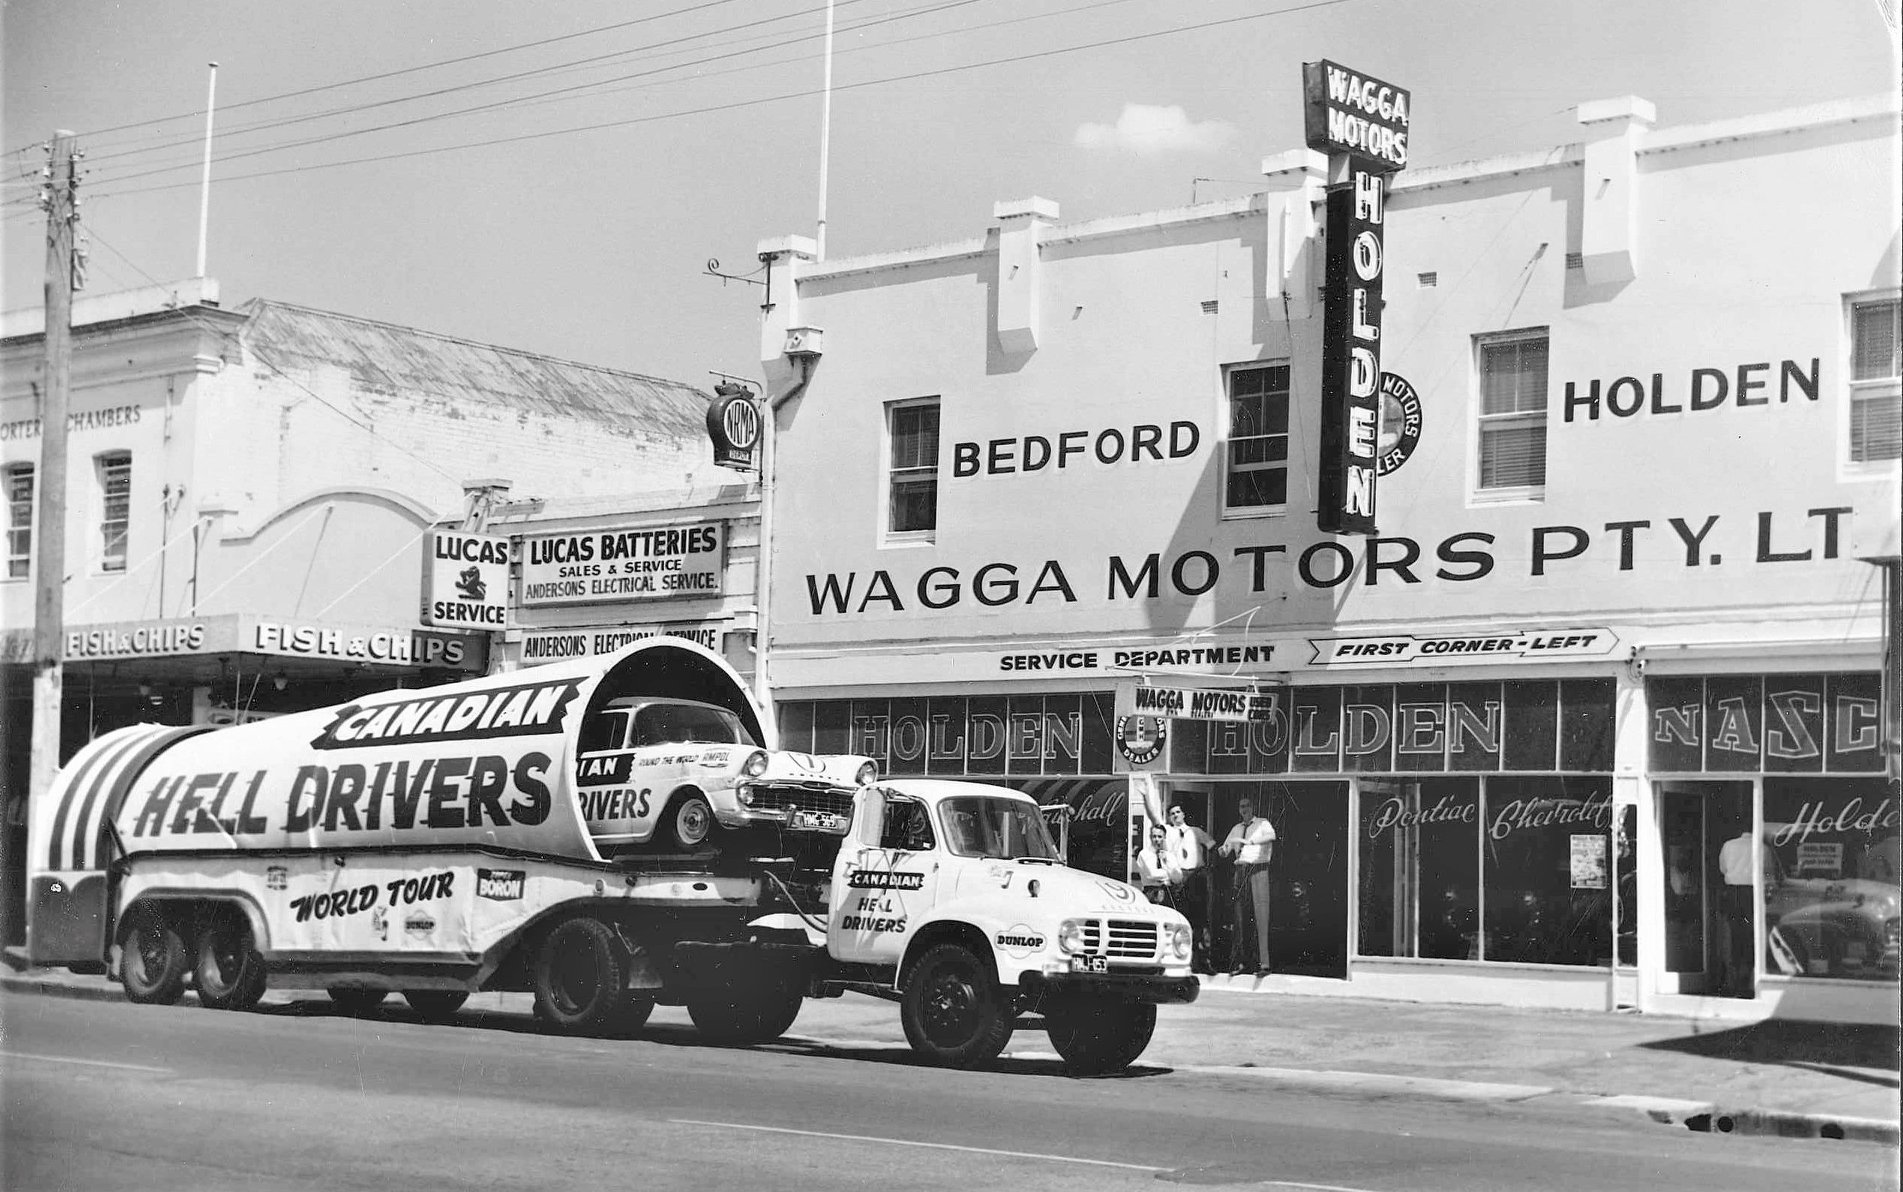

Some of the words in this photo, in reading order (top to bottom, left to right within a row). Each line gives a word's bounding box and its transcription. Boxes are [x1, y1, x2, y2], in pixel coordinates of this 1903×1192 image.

[1326, 65, 1409, 126] WAGGA
[1328, 107, 1408, 164] MOTORS
[1346, 171, 1383, 517] HOLDEN
[1383, 375, 1420, 438] MOTORS
[1563, 357, 1820, 423] HOLDEN
[66, 404, 141, 432] CHAMBERS
[727, 402, 755, 444] NRMA
[953, 420, 1200, 478] BEDFORD
[436, 535, 509, 565] LUCAS
[530, 536, 594, 565] LUCAS
[600, 526, 717, 561] BATTERIES
[805, 560, 1077, 615] WAGGA
[1108, 531, 1496, 600] MOTORS
[1531, 514, 1721, 576] PTY.
[525, 579, 586, 600] ANDERSONS
[592, 575, 654, 595] ELECTRICAL
[559, 564, 601, 578] SALES
[608, 564, 617, 575] &
[625, 559, 682, 574] SERVICE
[434, 602, 506, 625] SERVICE
[256, 622, 343, 655] FISH
[368, 632, 465, 665] CHIPS
[524, 635, 587, 658] ANDERSONS
[594, 632, 654, 656] ELECT
[665, 628, 717, 650] VICE
[1000, 653, 1098, 671] SERVICE
[1114, 646, 1275, 667] DEPARTMENT
[1336, 642, 1409, 657] FIRST
[335, 683, 569, 741] CANADIAN
[1136, 688, 1184, 710] WAGGA
[1190, 692, 1247, 713] MOTORS
[854, 711, 1082, 761] HOLDEN
[1211, 700, 1500, 756] HOLDEN
[1654, 690, 1878, 759] NASC
[703, 752, 730, 761] AMPOL
[133, 769, 268, 838] HELL
[281, 751, 552, 833] DRIVERS
[1488, 791, 1612, 840] Chevrolet
[1368, 795, 1476, 839] Pontiac
[290, 884, 379, 923] WORLD
[387, 871, 455, 907] TOUR
[480, 879, 521, 898] BORON
[854, 874, 920, 888] CANADIAN
[842, 915, 906, 933] DRIVERS
[997, 934, 1044, 948] DUNLOP
